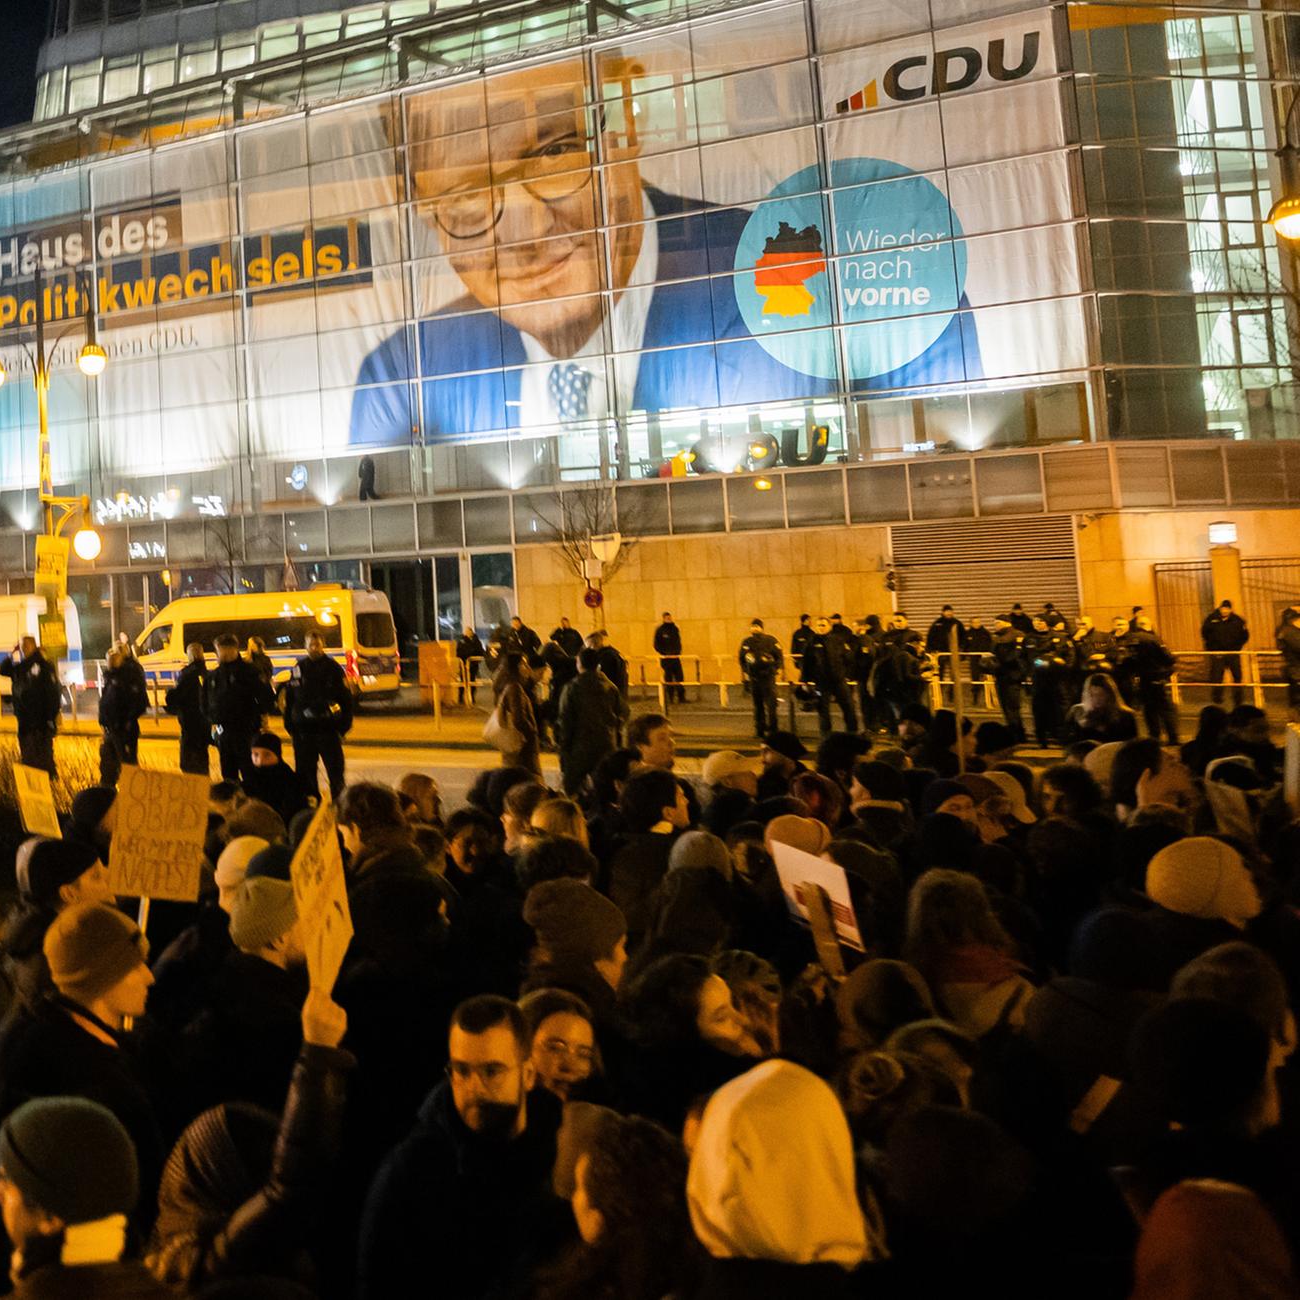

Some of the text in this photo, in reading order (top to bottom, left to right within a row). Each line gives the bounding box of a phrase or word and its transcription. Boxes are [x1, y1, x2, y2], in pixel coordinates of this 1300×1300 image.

[882, 30, 1041, 102] CDU
[97, 213, 170, 257] des
[845, 227, 947, 253] Wieder
[844, 255, 912, 280] nach
[843, 286, 932, 307] vorne
[148, 325, 200, 351] CDU.
[129, 769, 163, 803] OB
